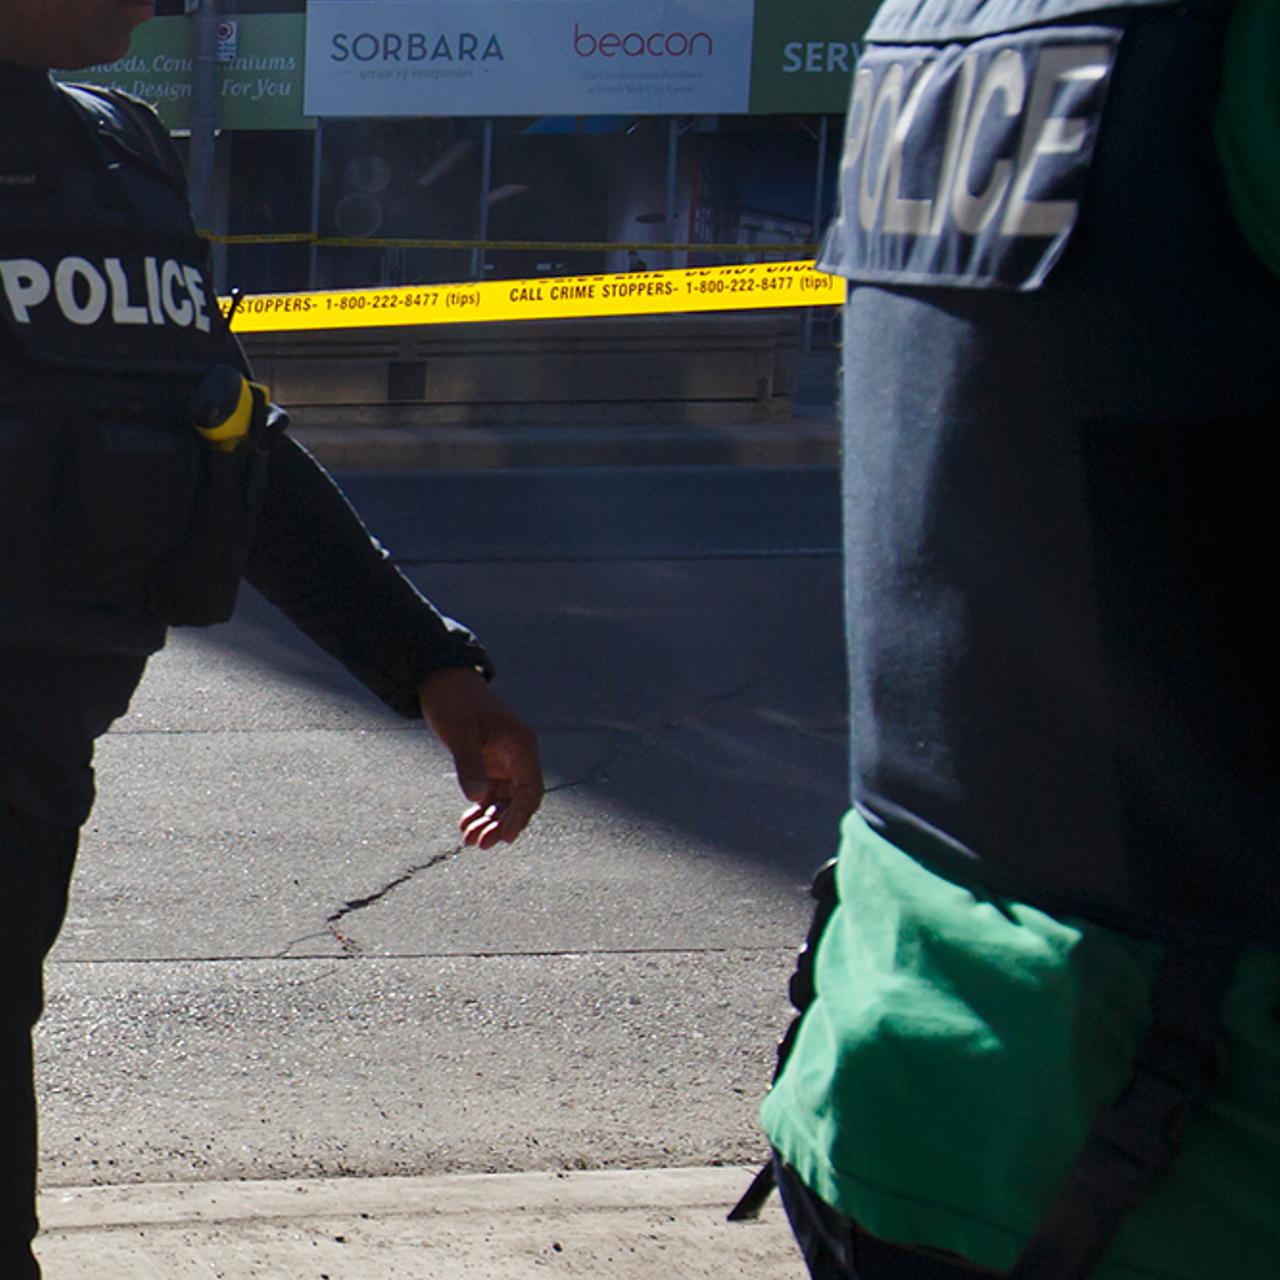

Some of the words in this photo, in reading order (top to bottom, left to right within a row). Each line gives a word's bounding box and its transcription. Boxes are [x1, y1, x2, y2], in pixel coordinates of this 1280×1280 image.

[331, 32, 505, 62] SORBARA
[573, 22, 713, 57] beacon
[251, 78, 292, 100] You
[844, 43, 1111, 236] POLICE
[326, 293, 439, 310] 1-800-222-8477
[445, 291, 481, 308] (tips)
[509, 287, 543, 303] CALL
[550, 283, 595, 300] CRIME
[601, 280, 679, 298] STOPPERS-
[686, 276, 793, 295] 1-800-222-8477
[799, 273, 834, 293] (tips)
